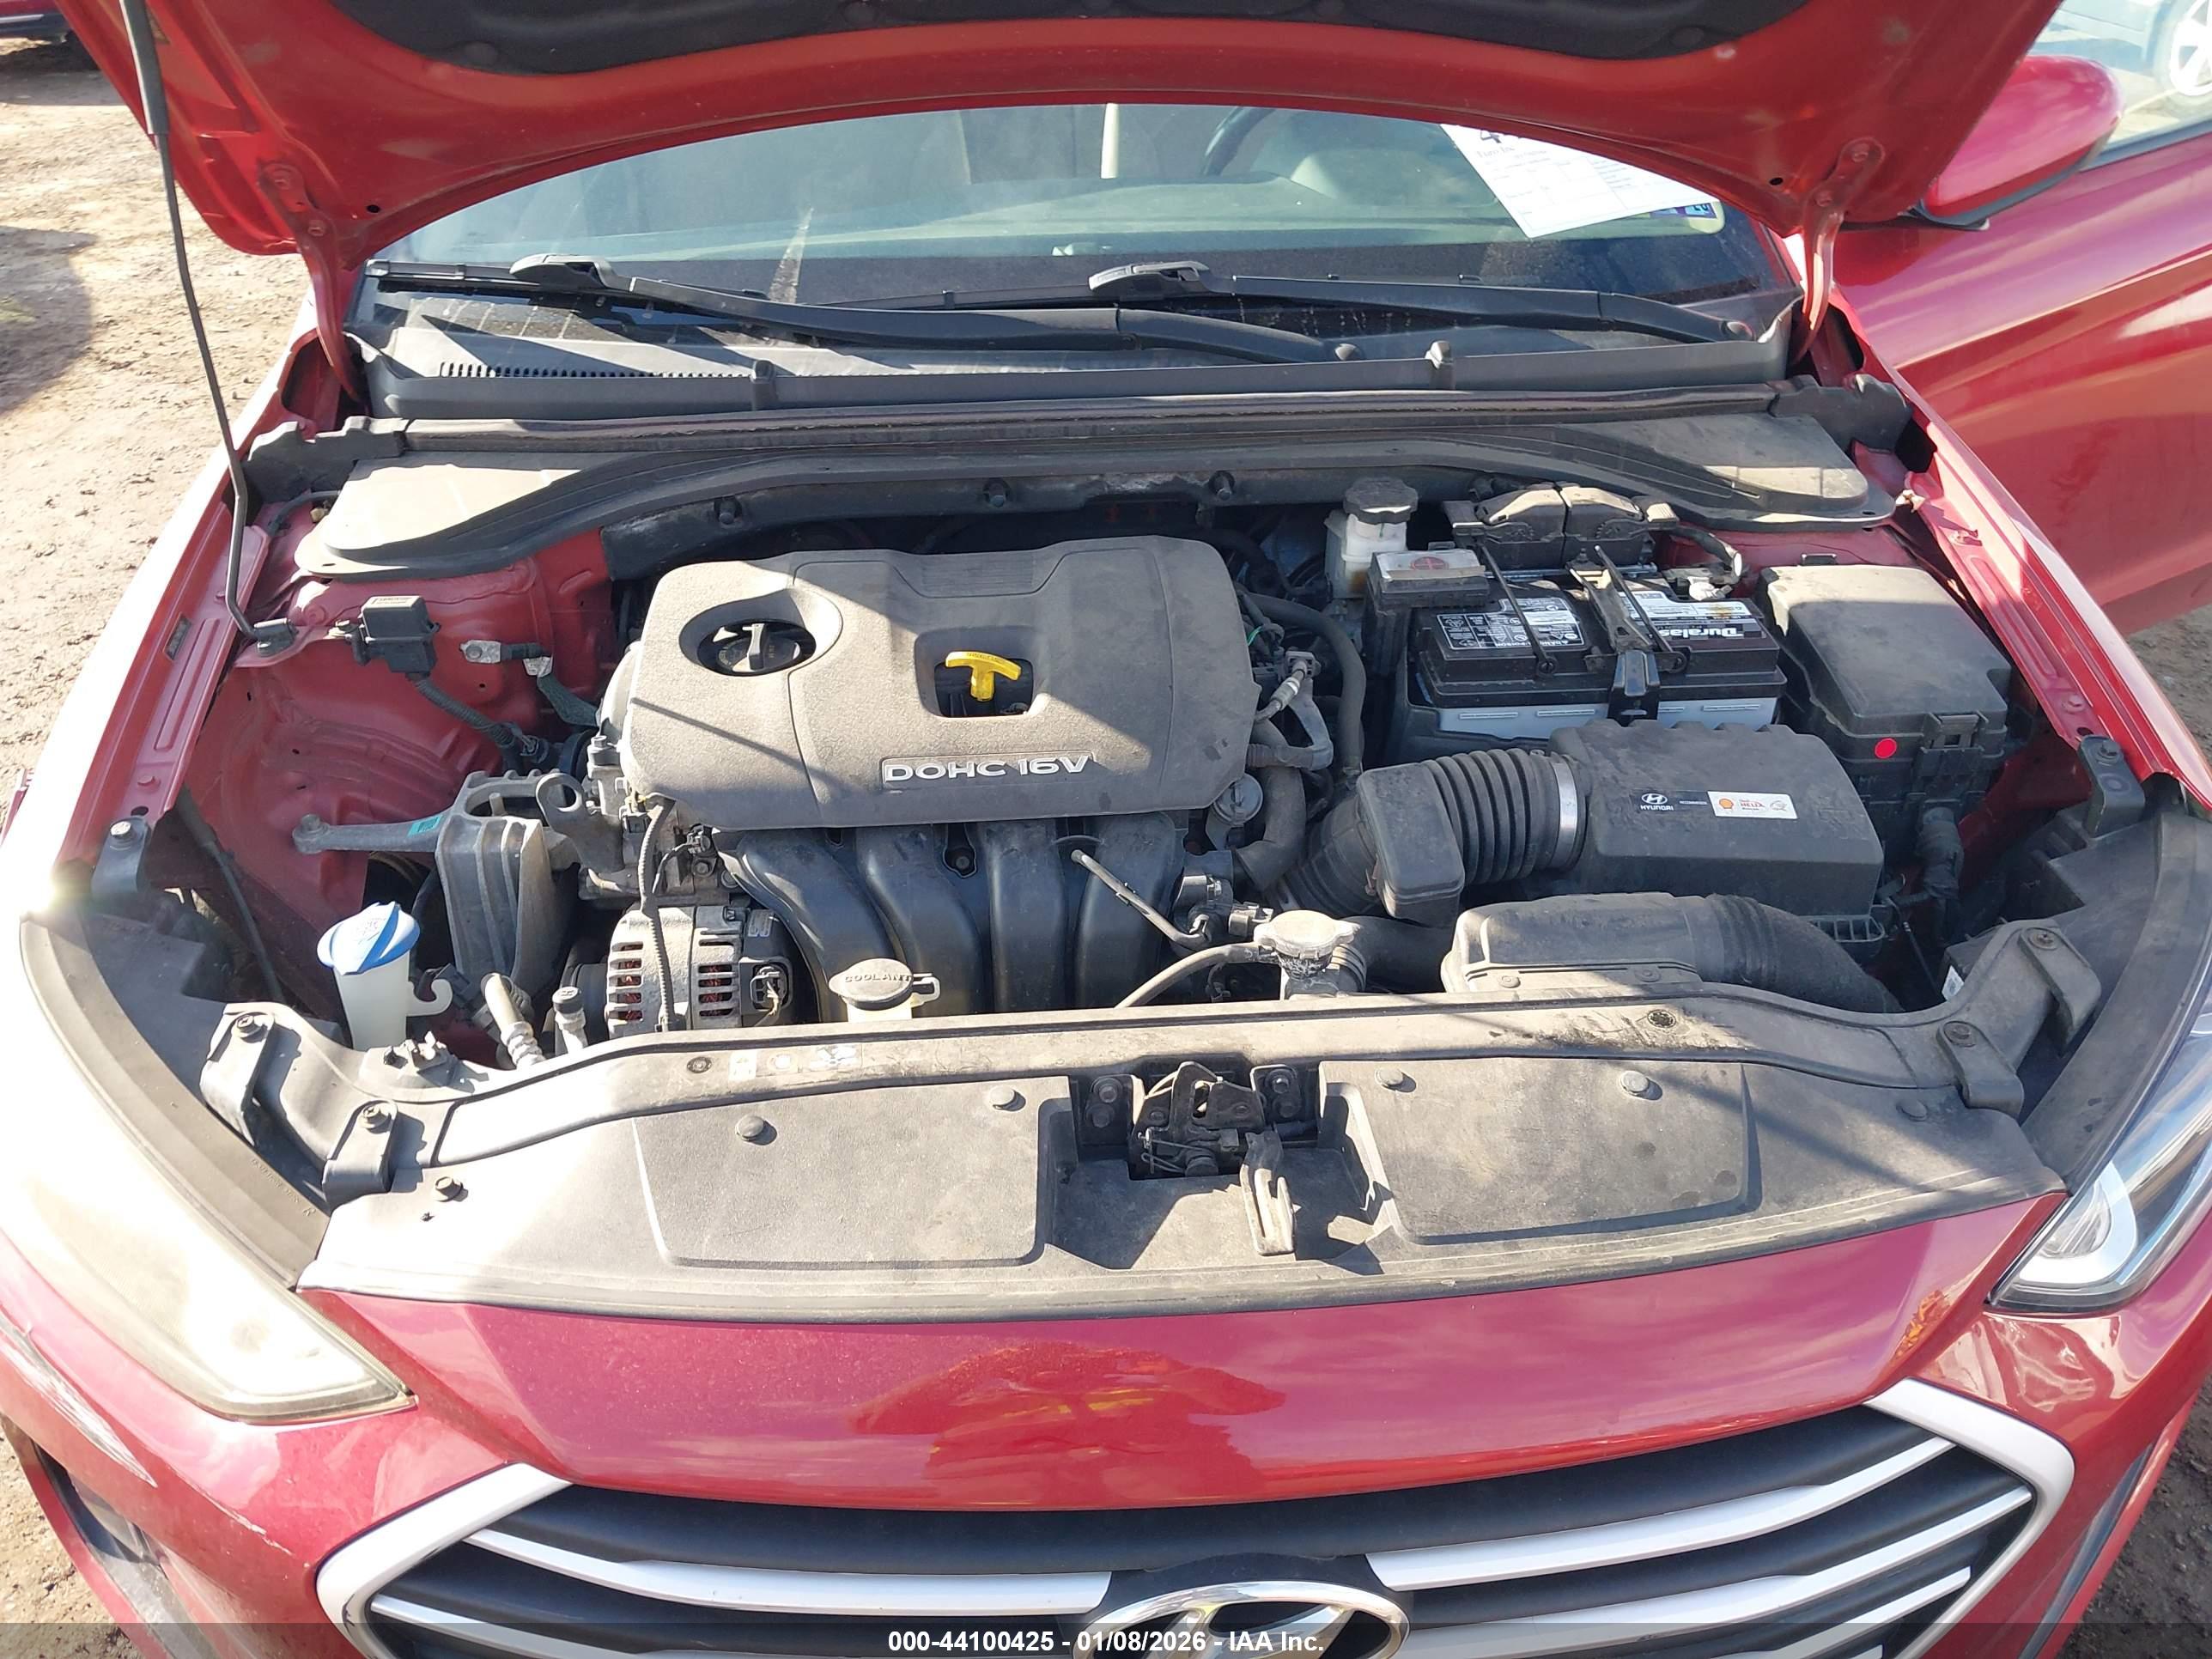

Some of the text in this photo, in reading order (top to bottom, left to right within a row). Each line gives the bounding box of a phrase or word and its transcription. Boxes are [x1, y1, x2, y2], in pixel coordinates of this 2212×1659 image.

[1659, 628, 1744, 638] Duralas
[885, 756, 1090, 782] DOHC 16V
[845, 974, 912, 983] COOLANT
